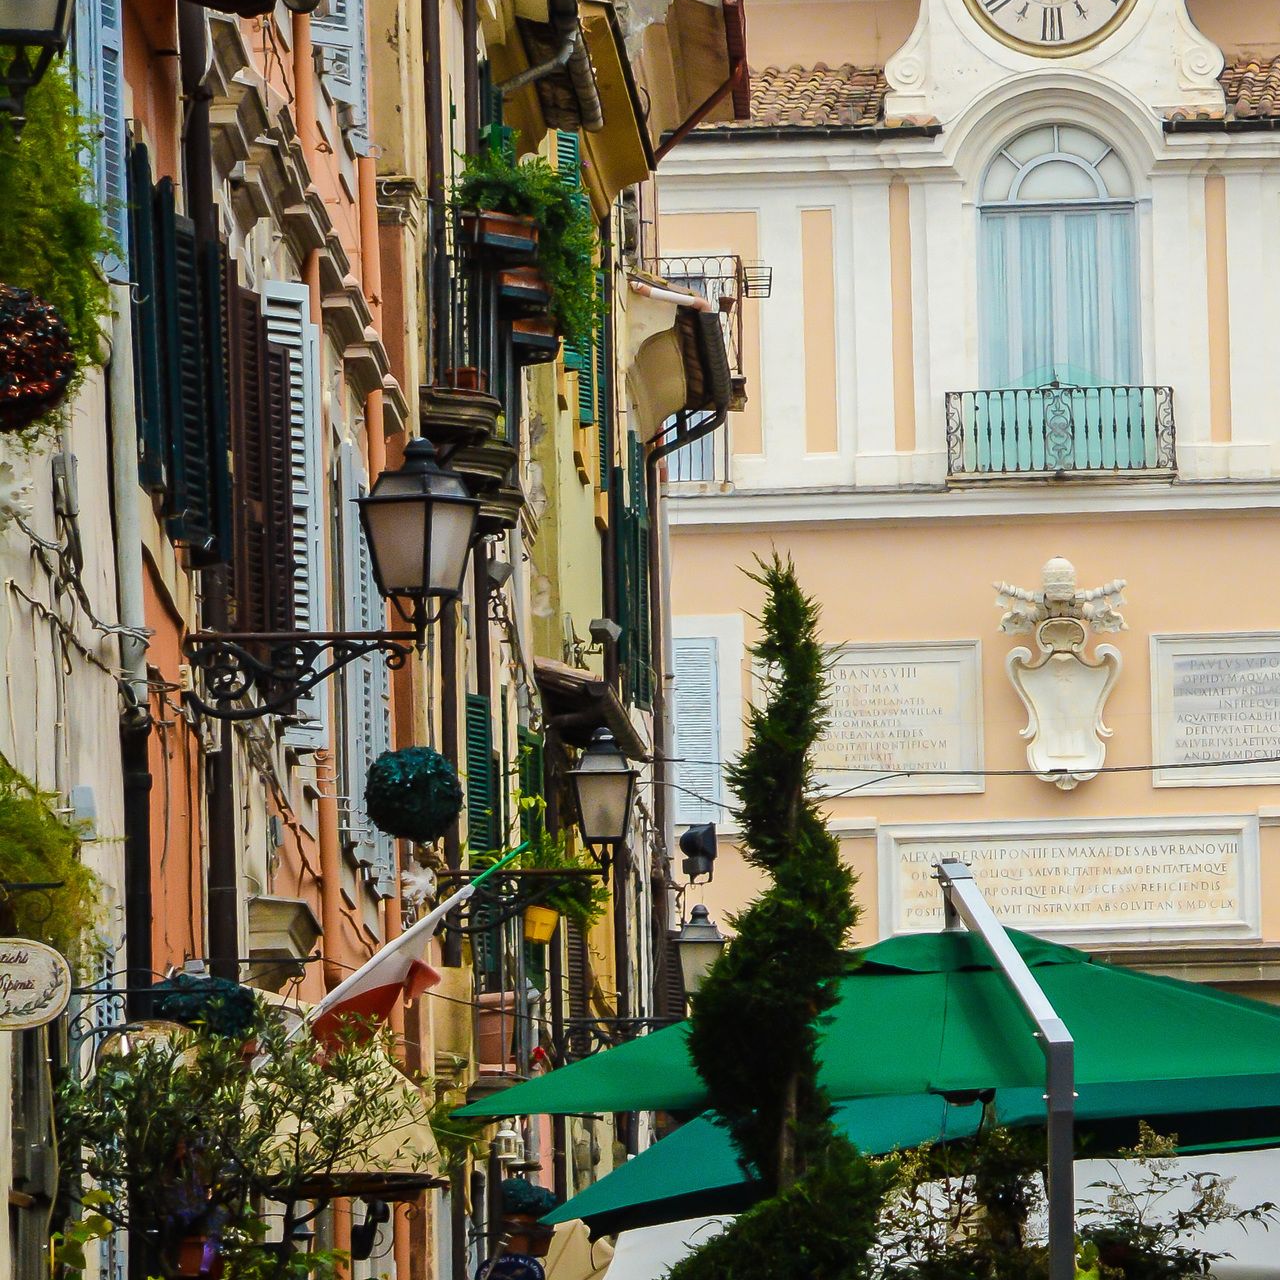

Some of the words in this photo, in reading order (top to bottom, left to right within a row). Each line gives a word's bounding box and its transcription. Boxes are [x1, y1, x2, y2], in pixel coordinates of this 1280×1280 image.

[828, 667, 888, 680] RBANVS
[890, 666, 918, 679] VIII
[900, 849, 978, 863] ALEXANDER
[983, 885, 1048, 899] RPORIQVE
[906, 906, 943, 918] POSIT
[0, 950, 29, 964] tichi
